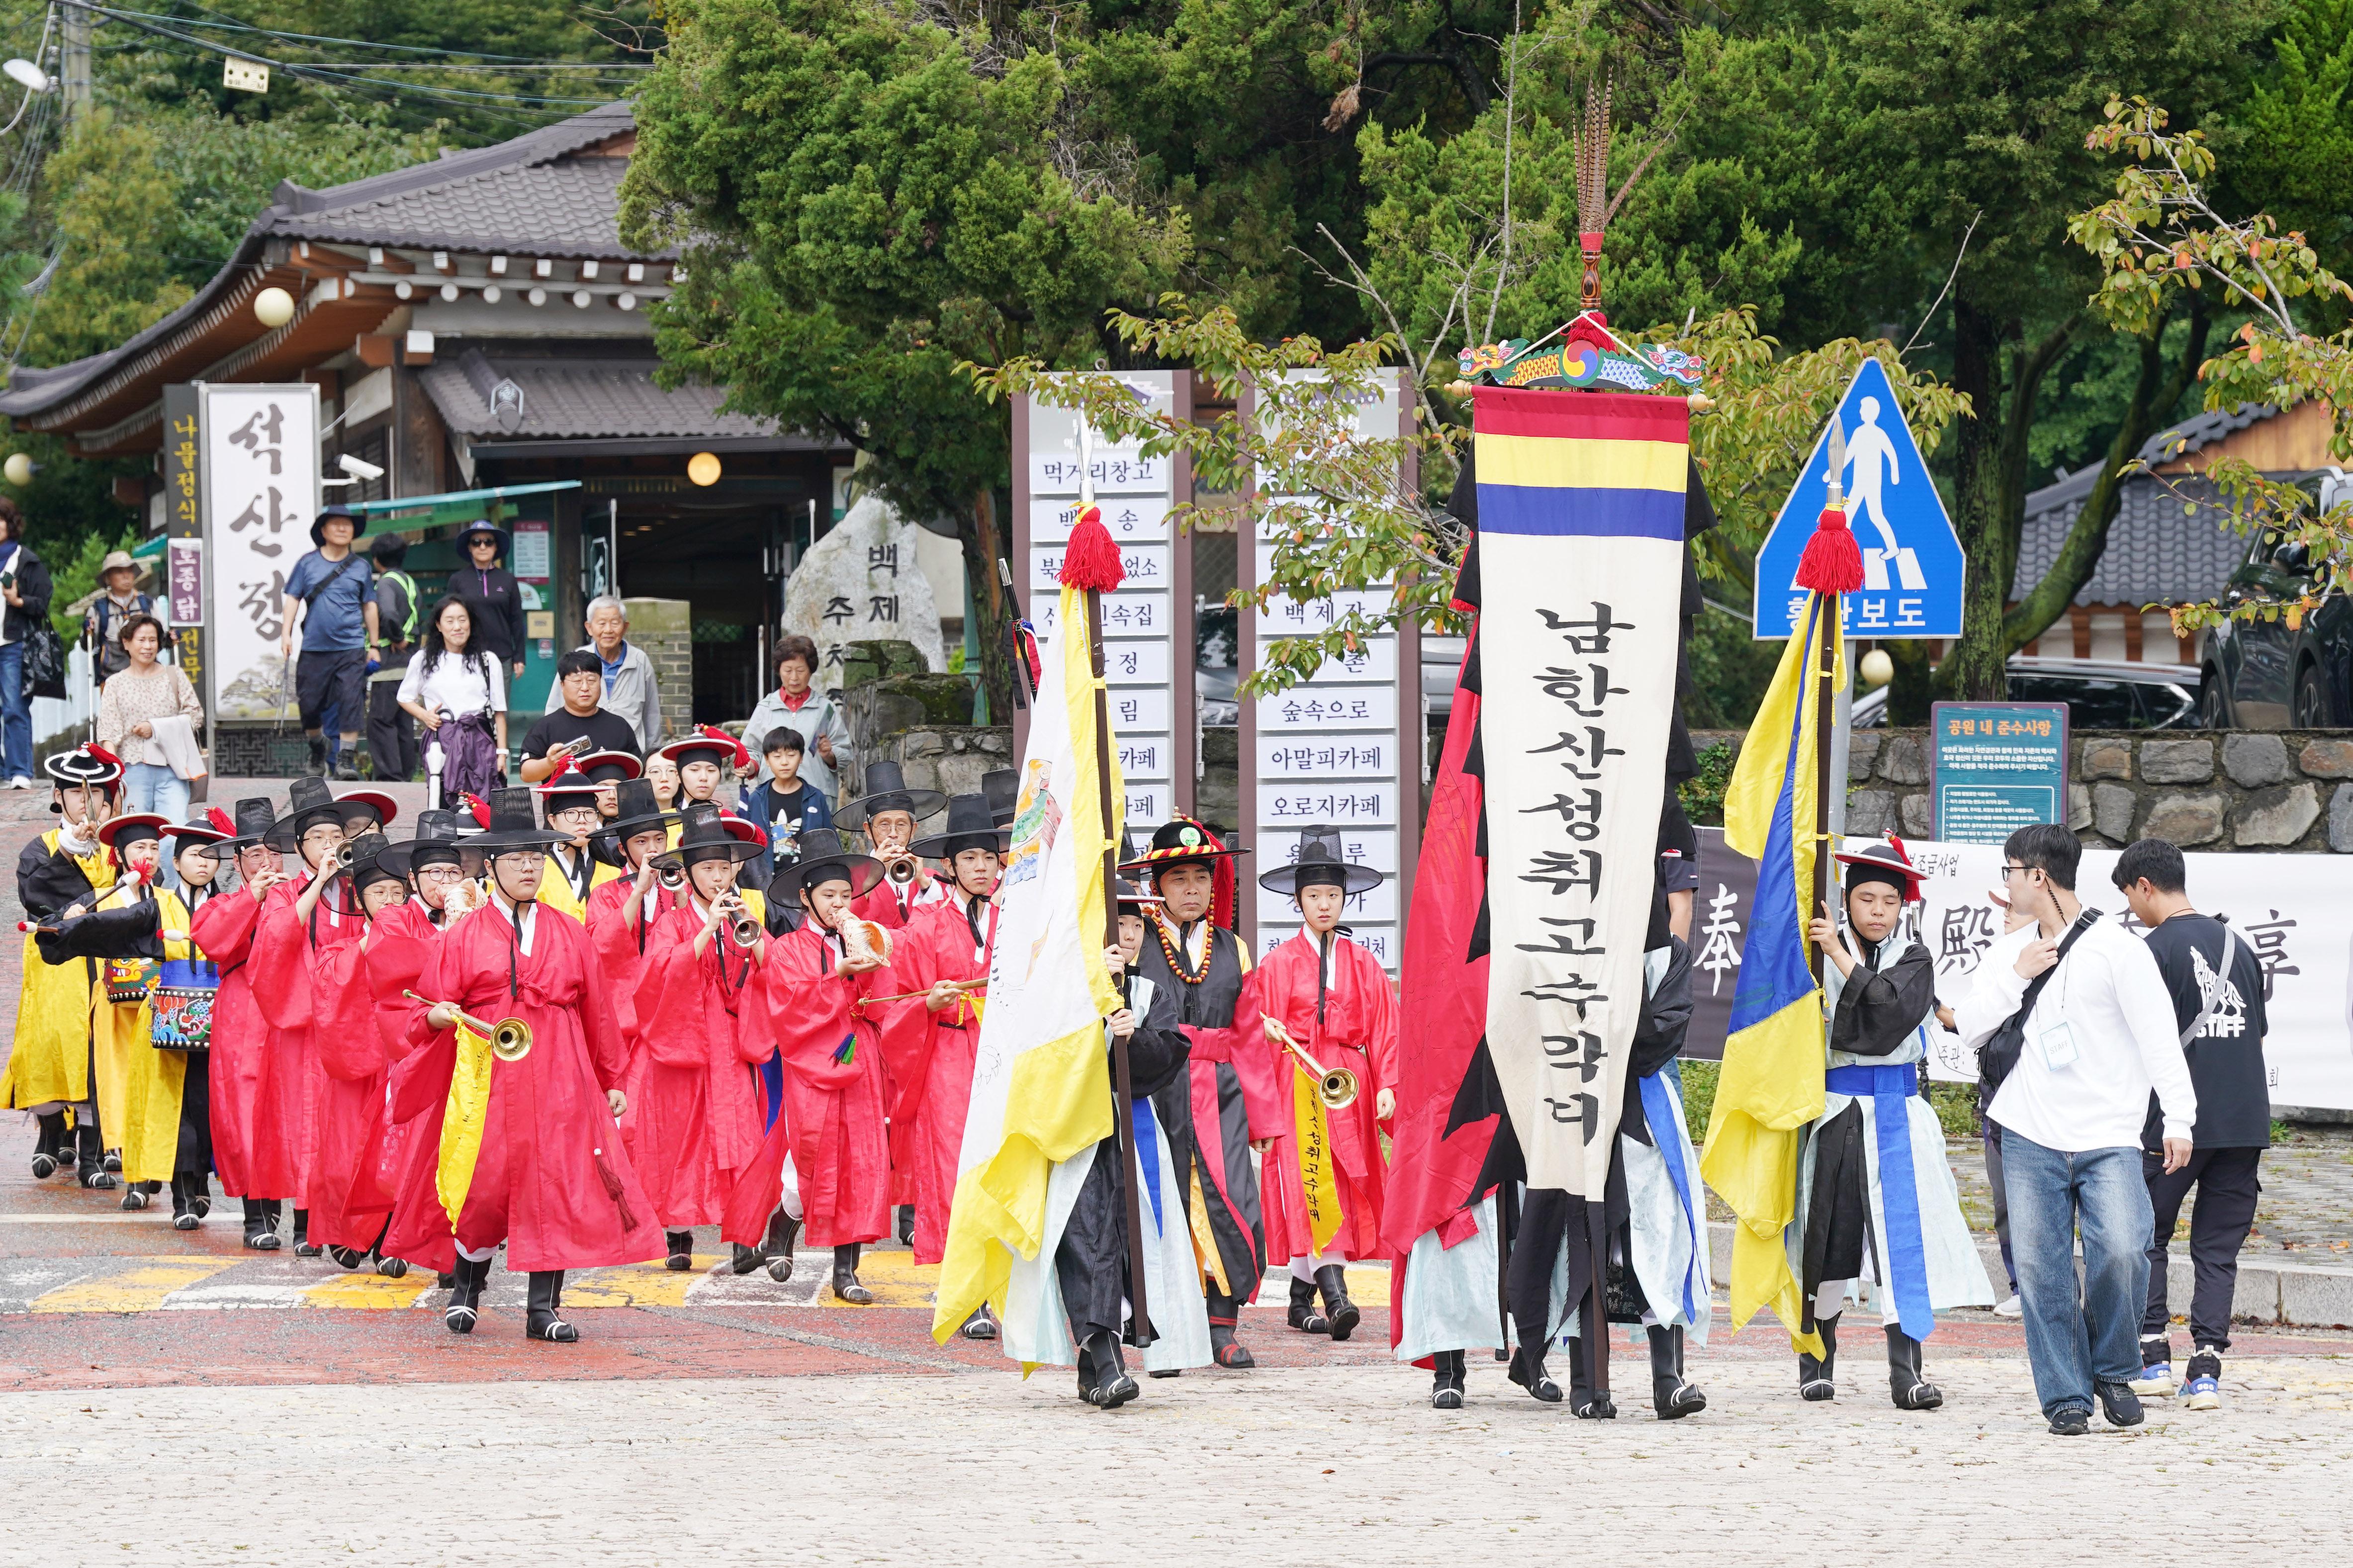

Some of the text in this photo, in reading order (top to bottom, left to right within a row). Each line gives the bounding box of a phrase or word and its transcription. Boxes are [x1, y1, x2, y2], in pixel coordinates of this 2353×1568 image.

[174, 414, 198, 525] 나물정식
[229, 404, 297, 641] 석산정
[868, 543, 899, 623] 백제
[1281, 699, 1370, 722] 숲속으로
[1948, 719, 2052, 737] 공원 내 준수사항
[1271, 746, 1380, 771] 아말피카페
[1270, 794, 1380, 818] 오로지카페
[1514, 602, 1636, 1147] 남한산성취고수악대
[1693, 882, 1742, 996] 奉
[2049, 1039, 2069, 1054] STAFF
